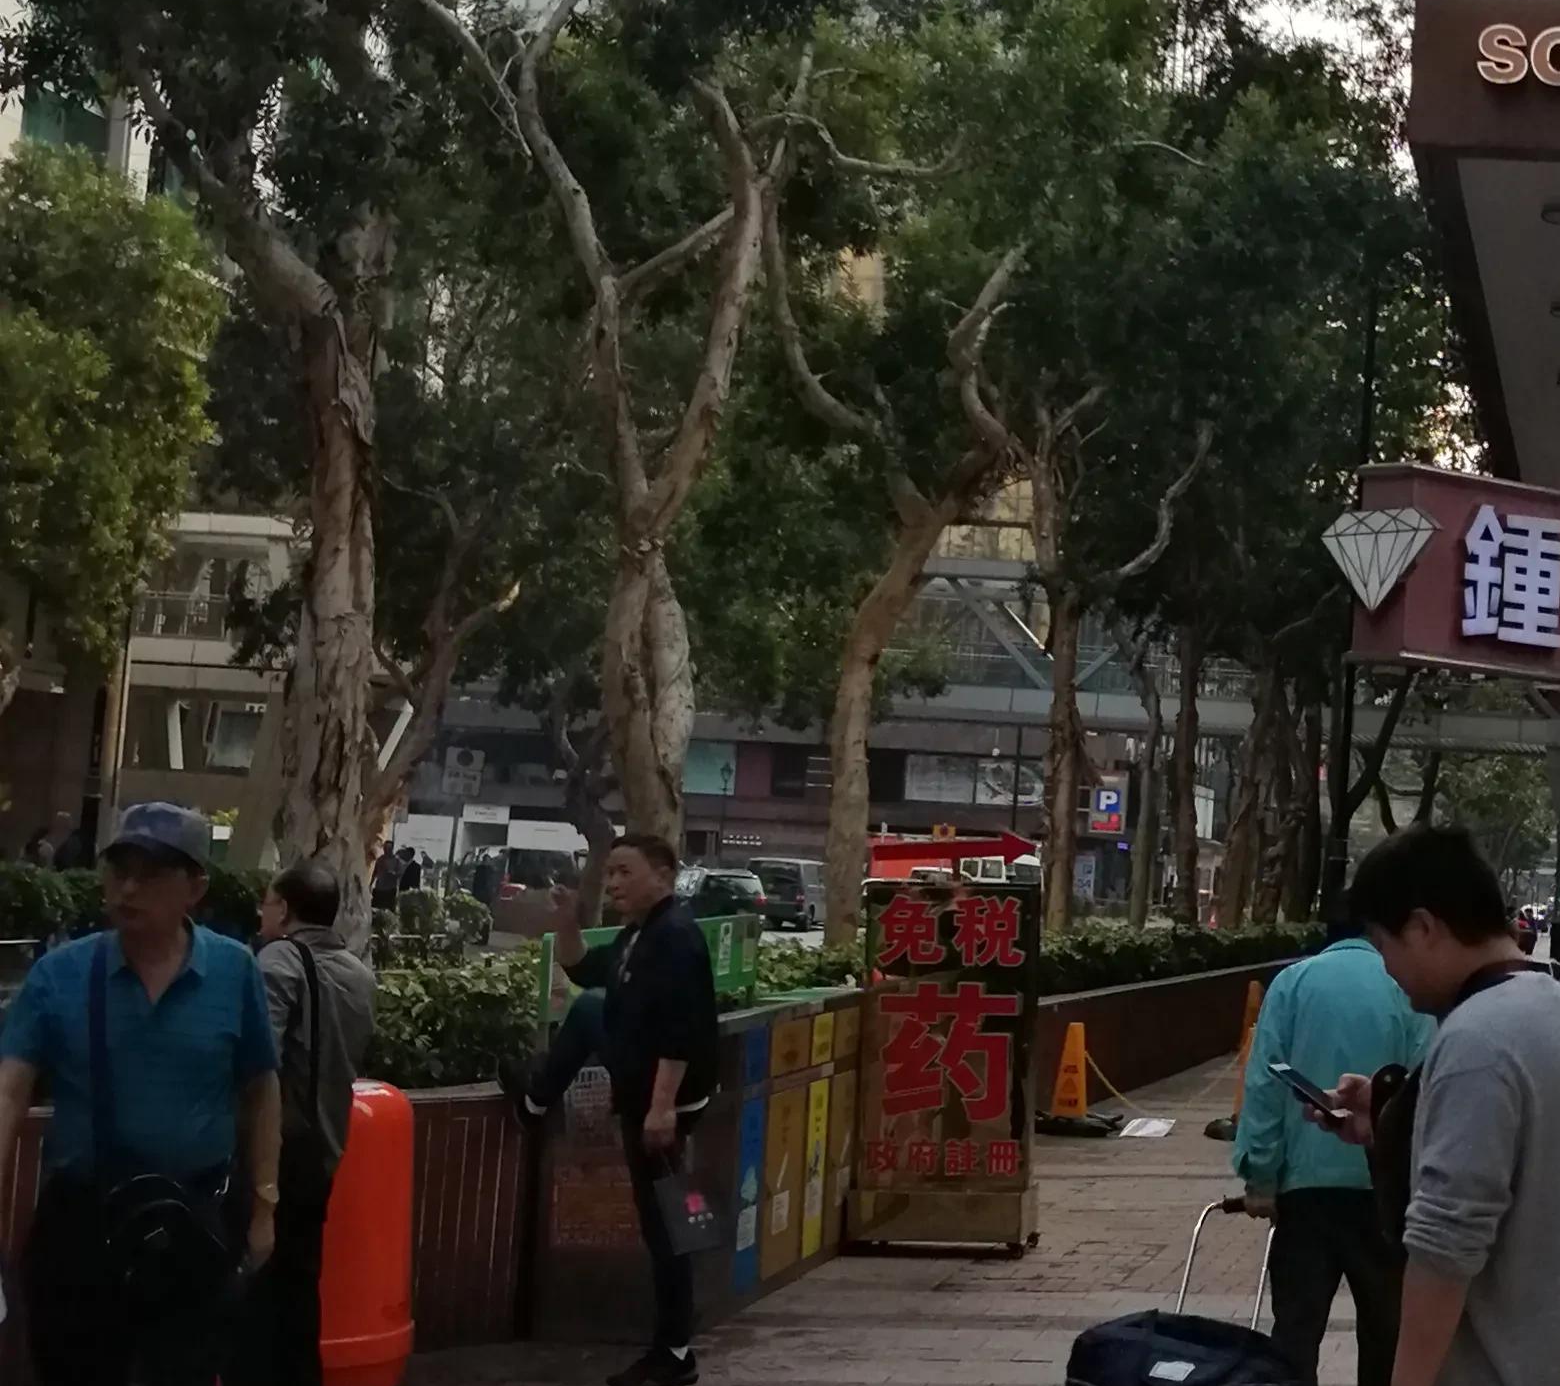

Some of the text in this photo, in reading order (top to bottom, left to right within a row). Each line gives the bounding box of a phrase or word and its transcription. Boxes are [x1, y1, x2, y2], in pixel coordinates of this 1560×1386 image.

[1099, 789, 1119, 812] P
[878, 980, 1023, 1123] 药
[865, 1139, 1024, 1178] 政府註冊
